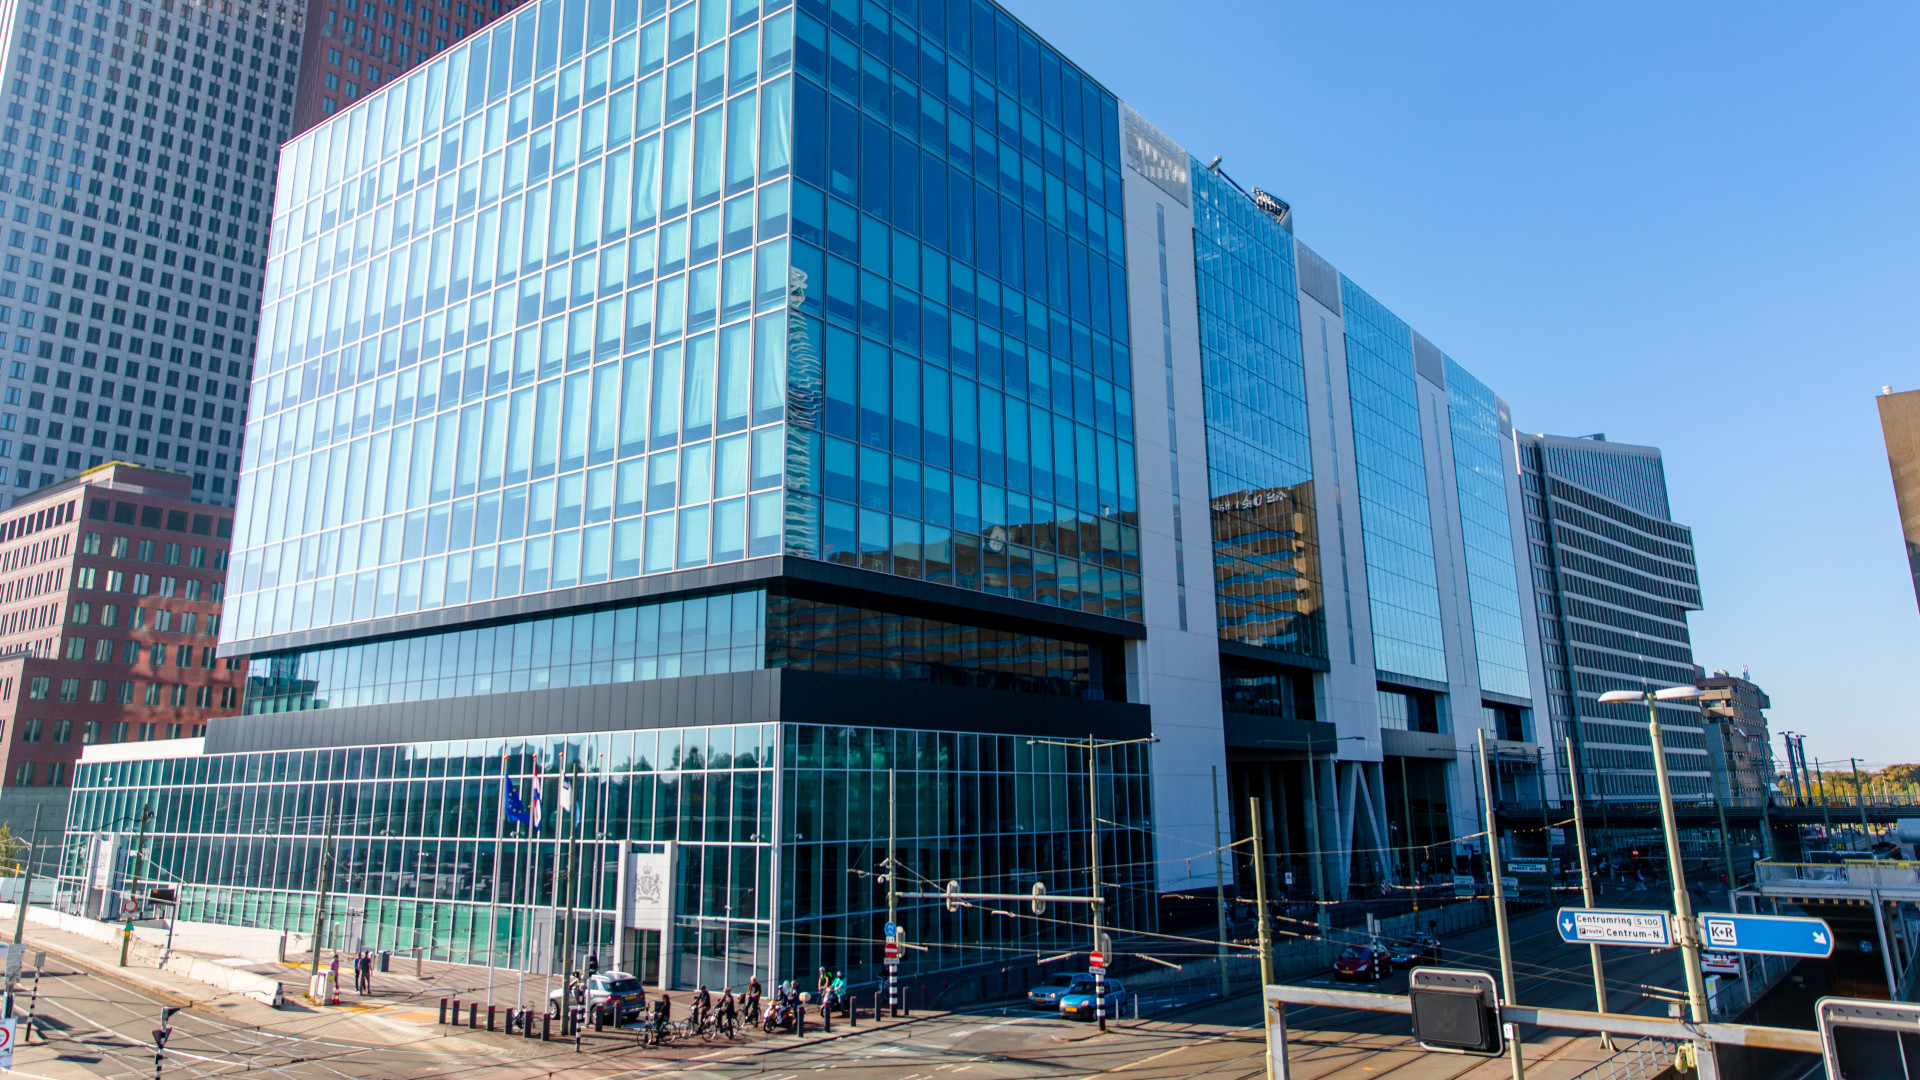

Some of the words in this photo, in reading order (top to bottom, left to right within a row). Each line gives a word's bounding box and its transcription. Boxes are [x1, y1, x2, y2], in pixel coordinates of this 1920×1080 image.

[1576, 914, 1632, 926] Centrumring
[1644, 918, 1658, 926] 100
[1711, 926, 1734, 938] K+R
